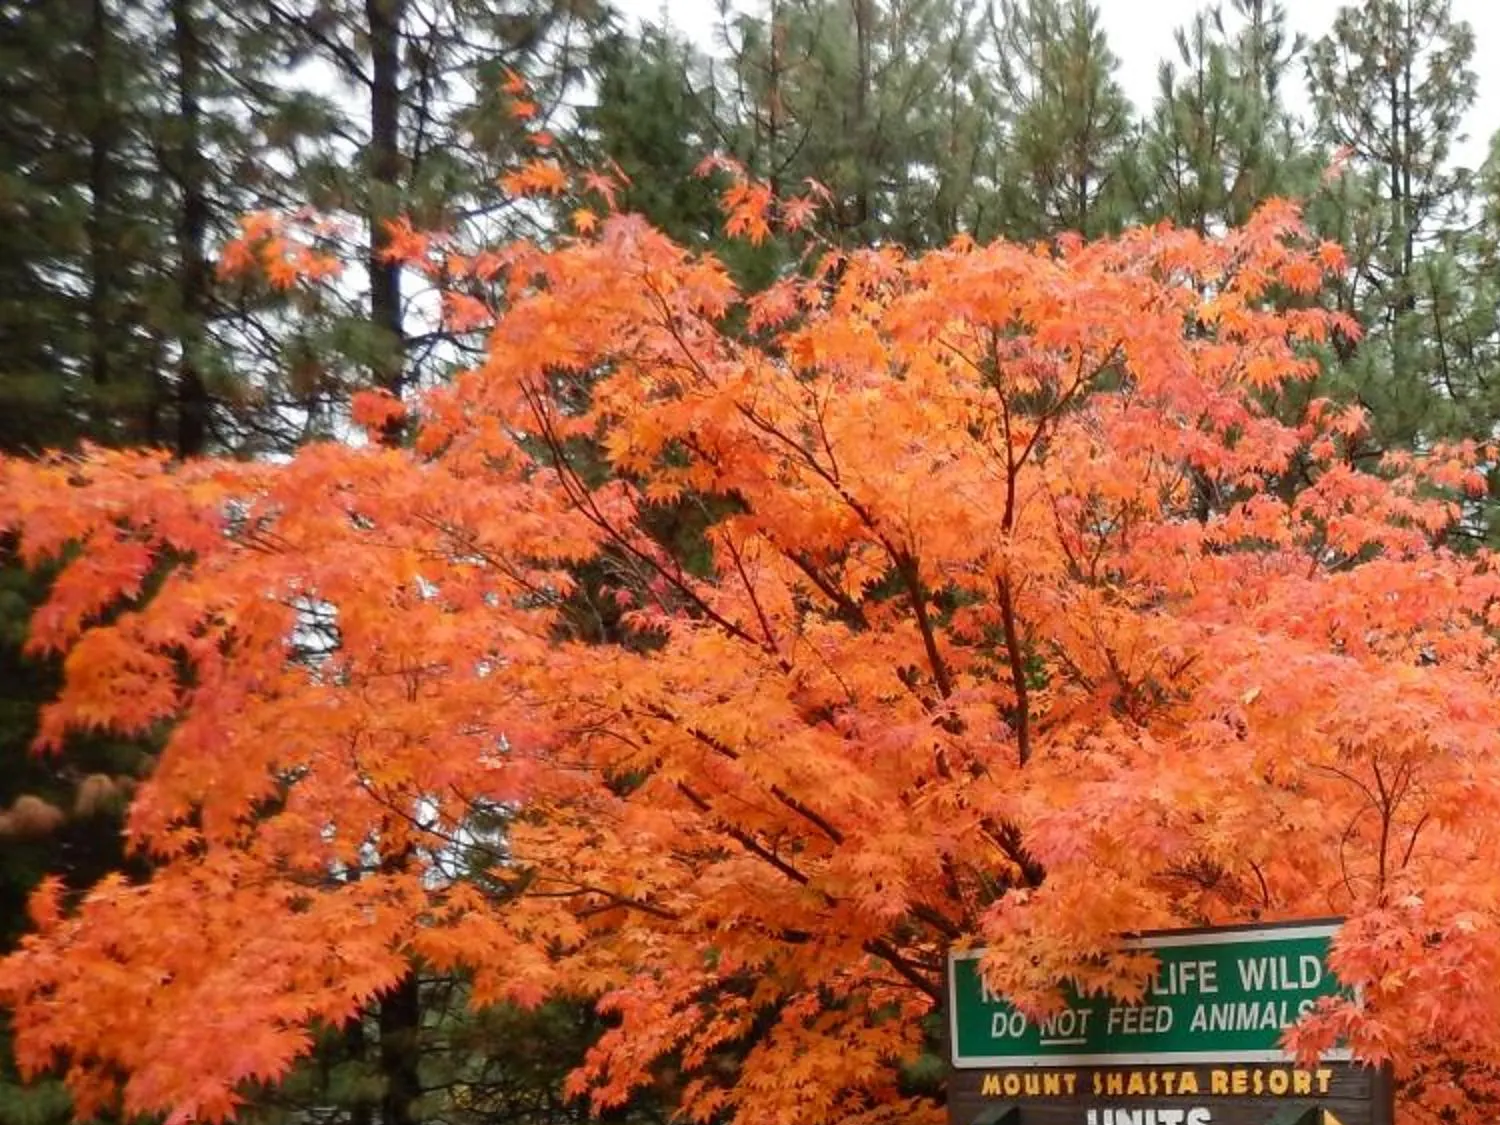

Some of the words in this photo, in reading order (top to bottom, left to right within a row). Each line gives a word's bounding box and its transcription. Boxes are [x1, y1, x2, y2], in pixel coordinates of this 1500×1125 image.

[1238, 955, 1322, 992] WILD
[991, 1012, 1026, 1038] DO
[1040, 1009, 1092, 1037] NOT
[1107, 1005, 1173, 1035] FEED
[981, 1072, 1076, 1096] MOUNT
[1093, 1070, 1198, 1096] SHASTA
[1211, 1068, 1333, 1095] RESORT
